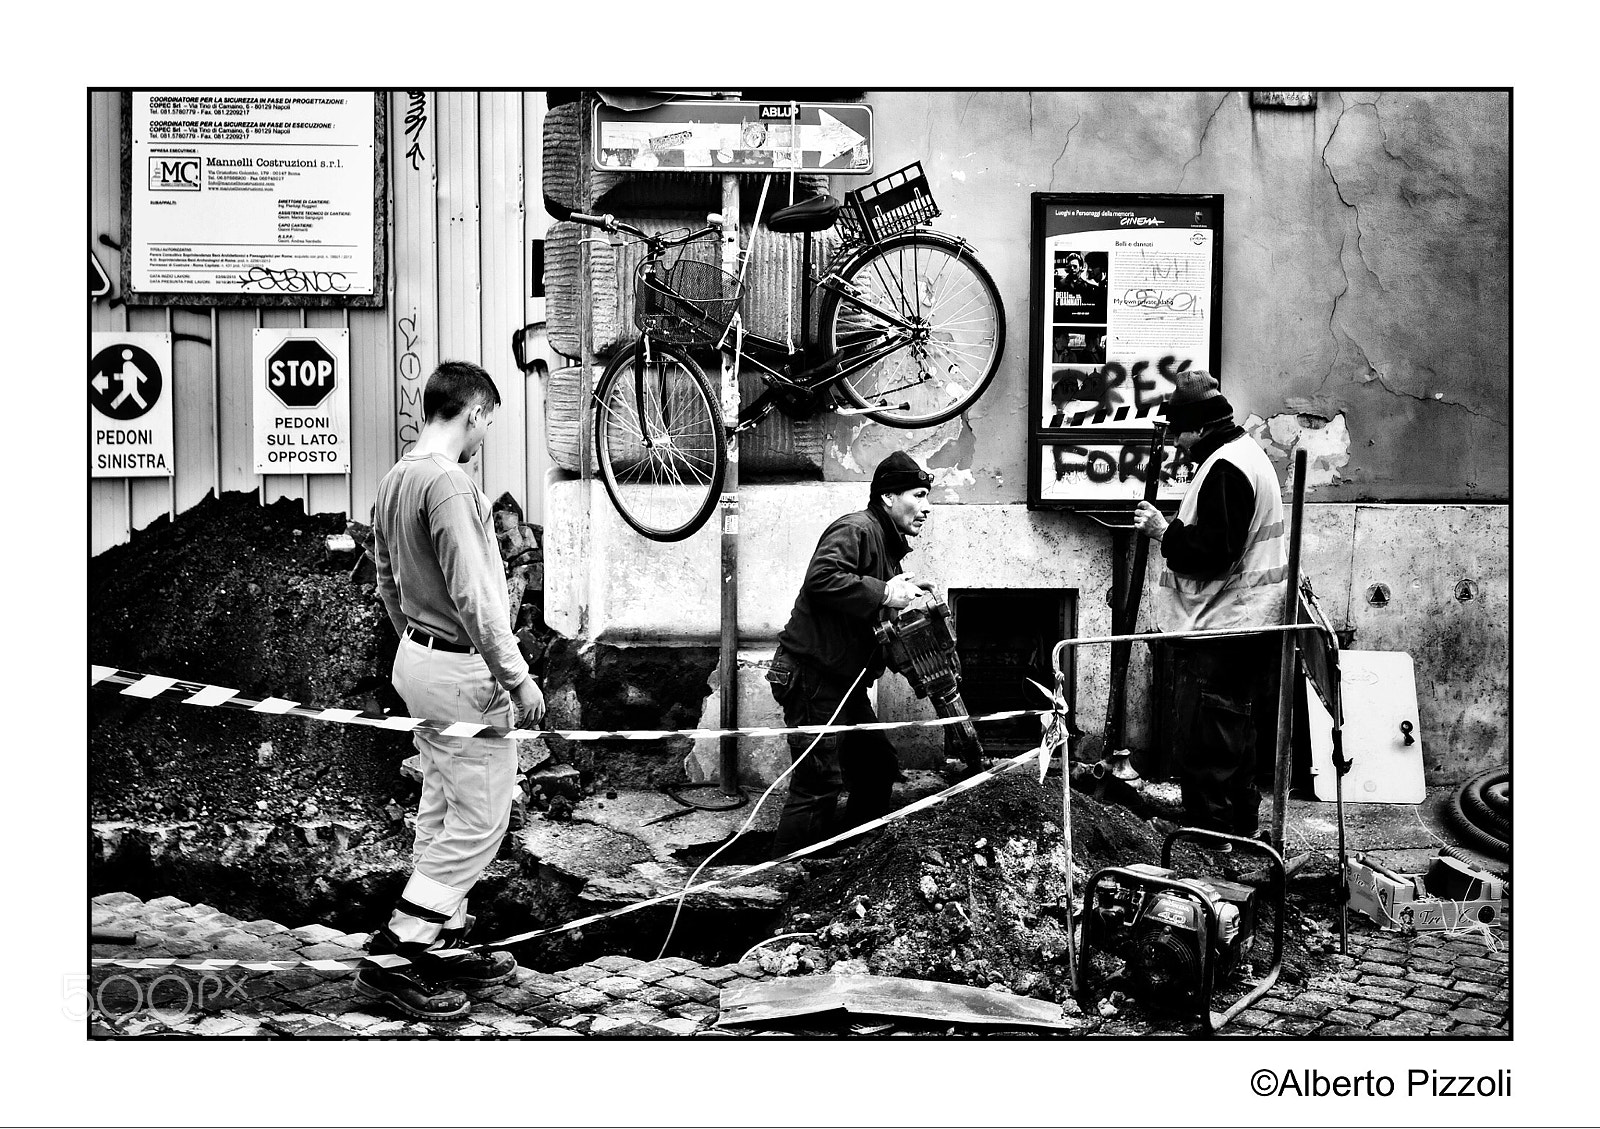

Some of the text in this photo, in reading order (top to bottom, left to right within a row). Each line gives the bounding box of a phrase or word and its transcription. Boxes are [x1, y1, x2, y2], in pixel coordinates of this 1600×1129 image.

[761, 107, 799, 117] ABLUP
[206, 157, 344, 168] Mannelli Costruzioni s.r.l.
[1076, 210, 1101, 218] Personaggi
[1120, 216, 1165, 226] CINEMA
[1114, 298, 1123, 306] My
[271, 360, 333, 387] STOP
[275, 417, 330, 429] PEDONI
[96, 430, 152, 445] PEDONI
[267, 434, 338, 446] SUL LATO
[97, 453, 166, 469] SINISTRA
[268, 451, 338, 462] OPPOSTO
